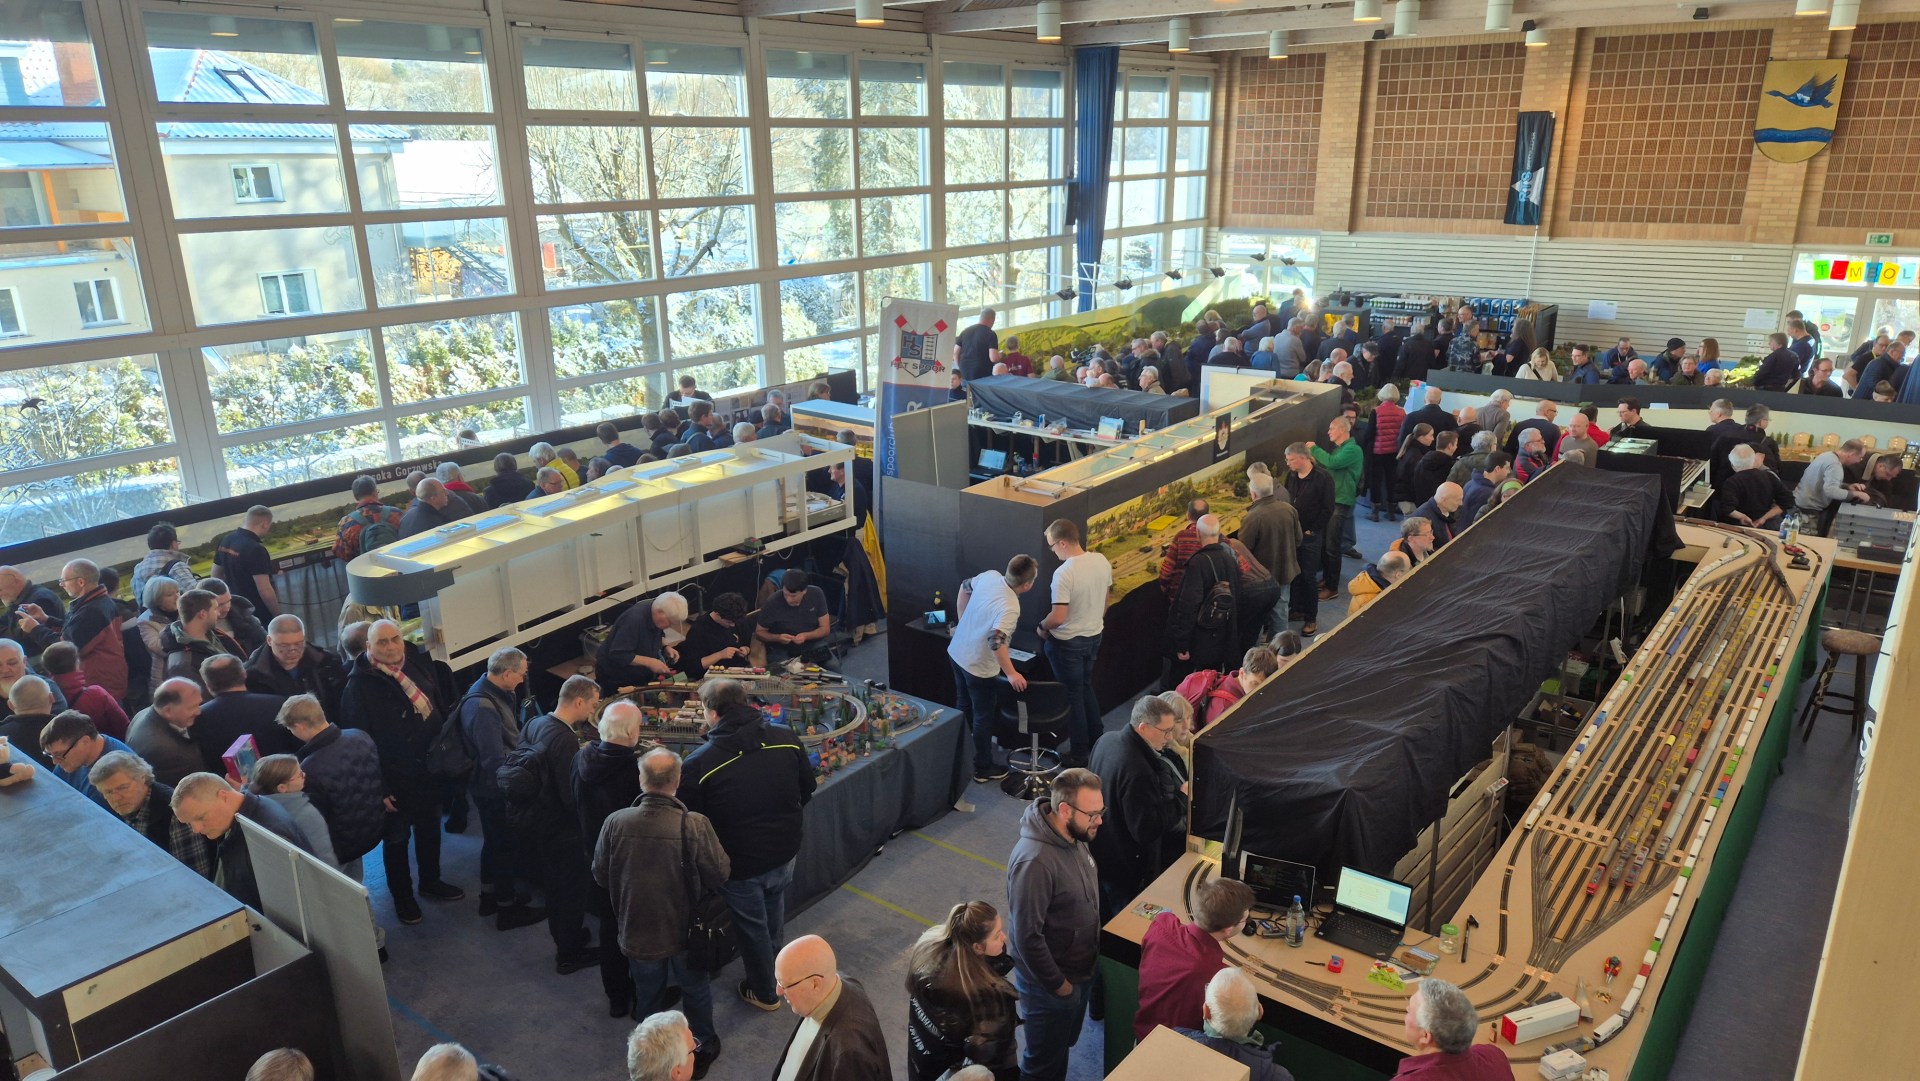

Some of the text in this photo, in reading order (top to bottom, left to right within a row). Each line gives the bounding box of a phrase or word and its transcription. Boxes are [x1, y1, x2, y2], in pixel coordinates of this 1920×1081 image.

[1817, 263, 1919, 281] TMBOL
[912, 361, 946, 373] SPOOR
[357, 469, 392, 482] soka
